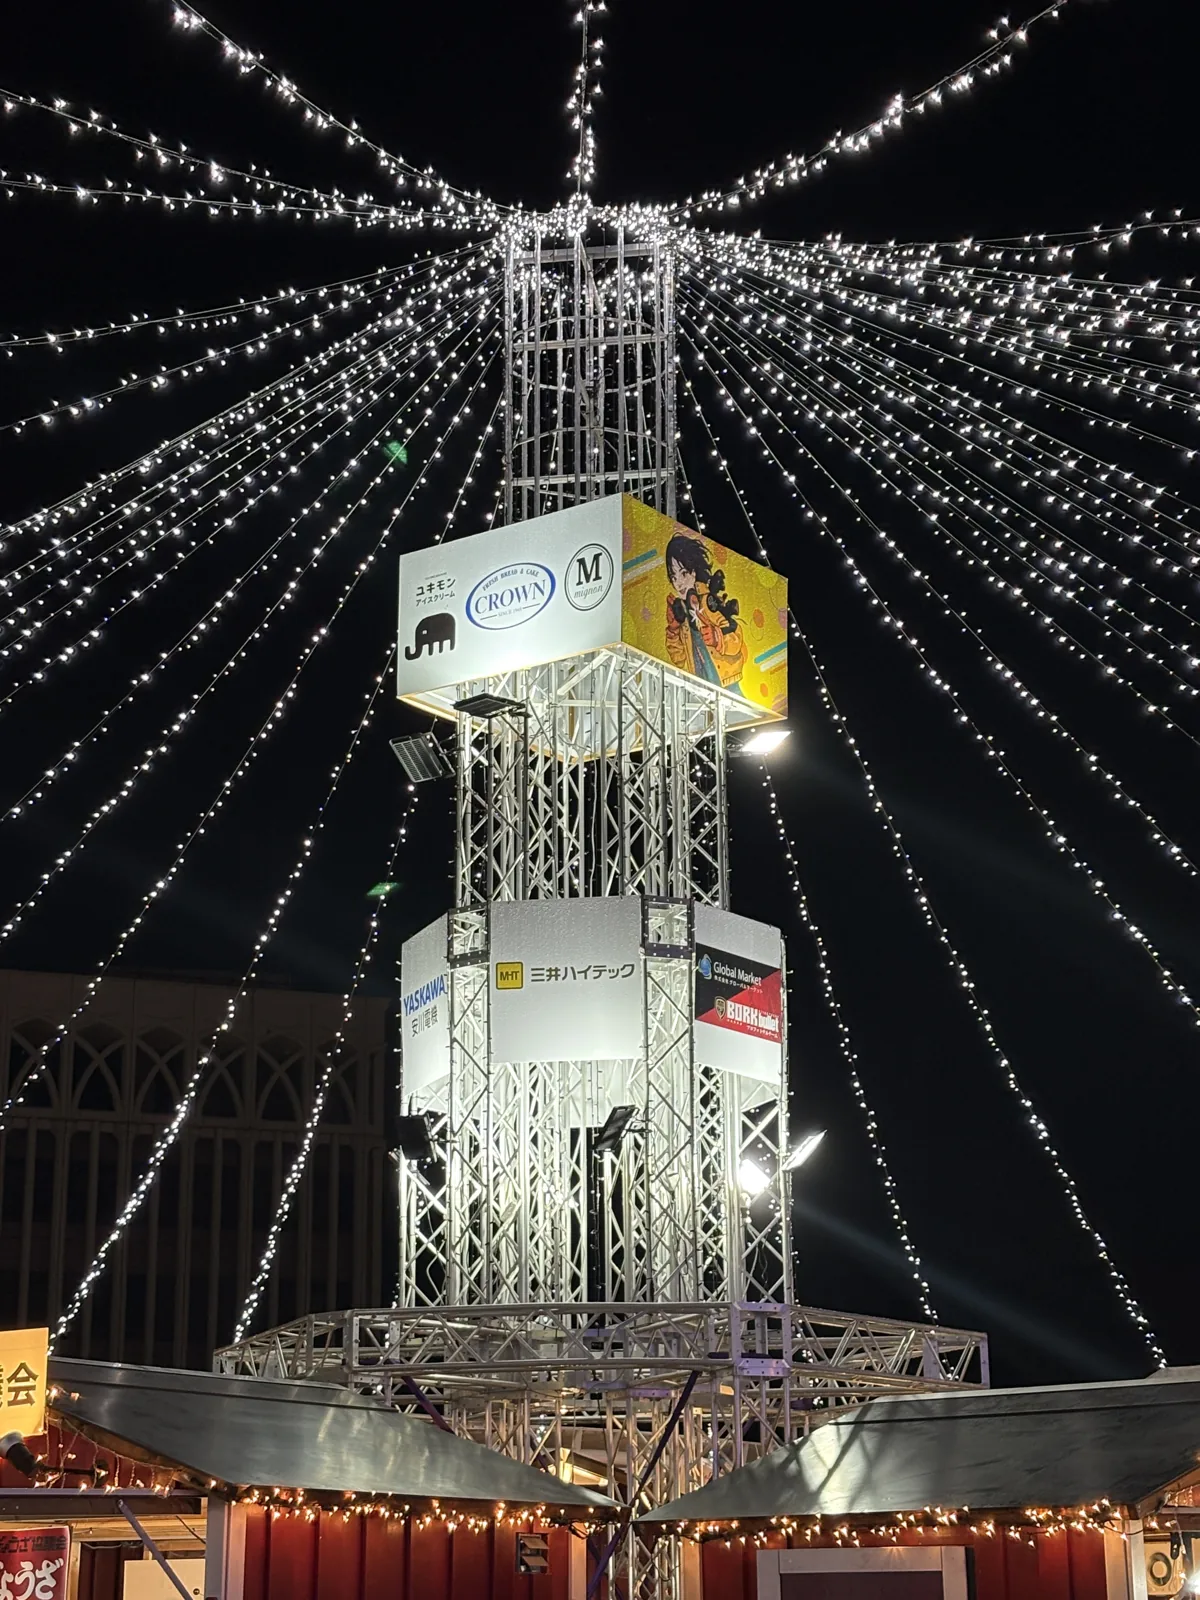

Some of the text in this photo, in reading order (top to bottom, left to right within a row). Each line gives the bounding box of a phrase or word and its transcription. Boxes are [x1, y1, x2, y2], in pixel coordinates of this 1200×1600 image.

[576, 552, 602, 586] M
[416, 578, 456, 596] ユキモン
[416, 590, 456, 607] アイスクリーム
[475, 579, 546, 614] CROWN
[574, 585, 603, 599] mignon
[531, 963, 635, 982] 三井ハイテック
[713, 962, 762, 986] Global Market
[404, 974, 445, 1016] YASKAWA
[0, 1362, 39, 1407] 会
[0, 1557, 65, 1600] ょうざ
